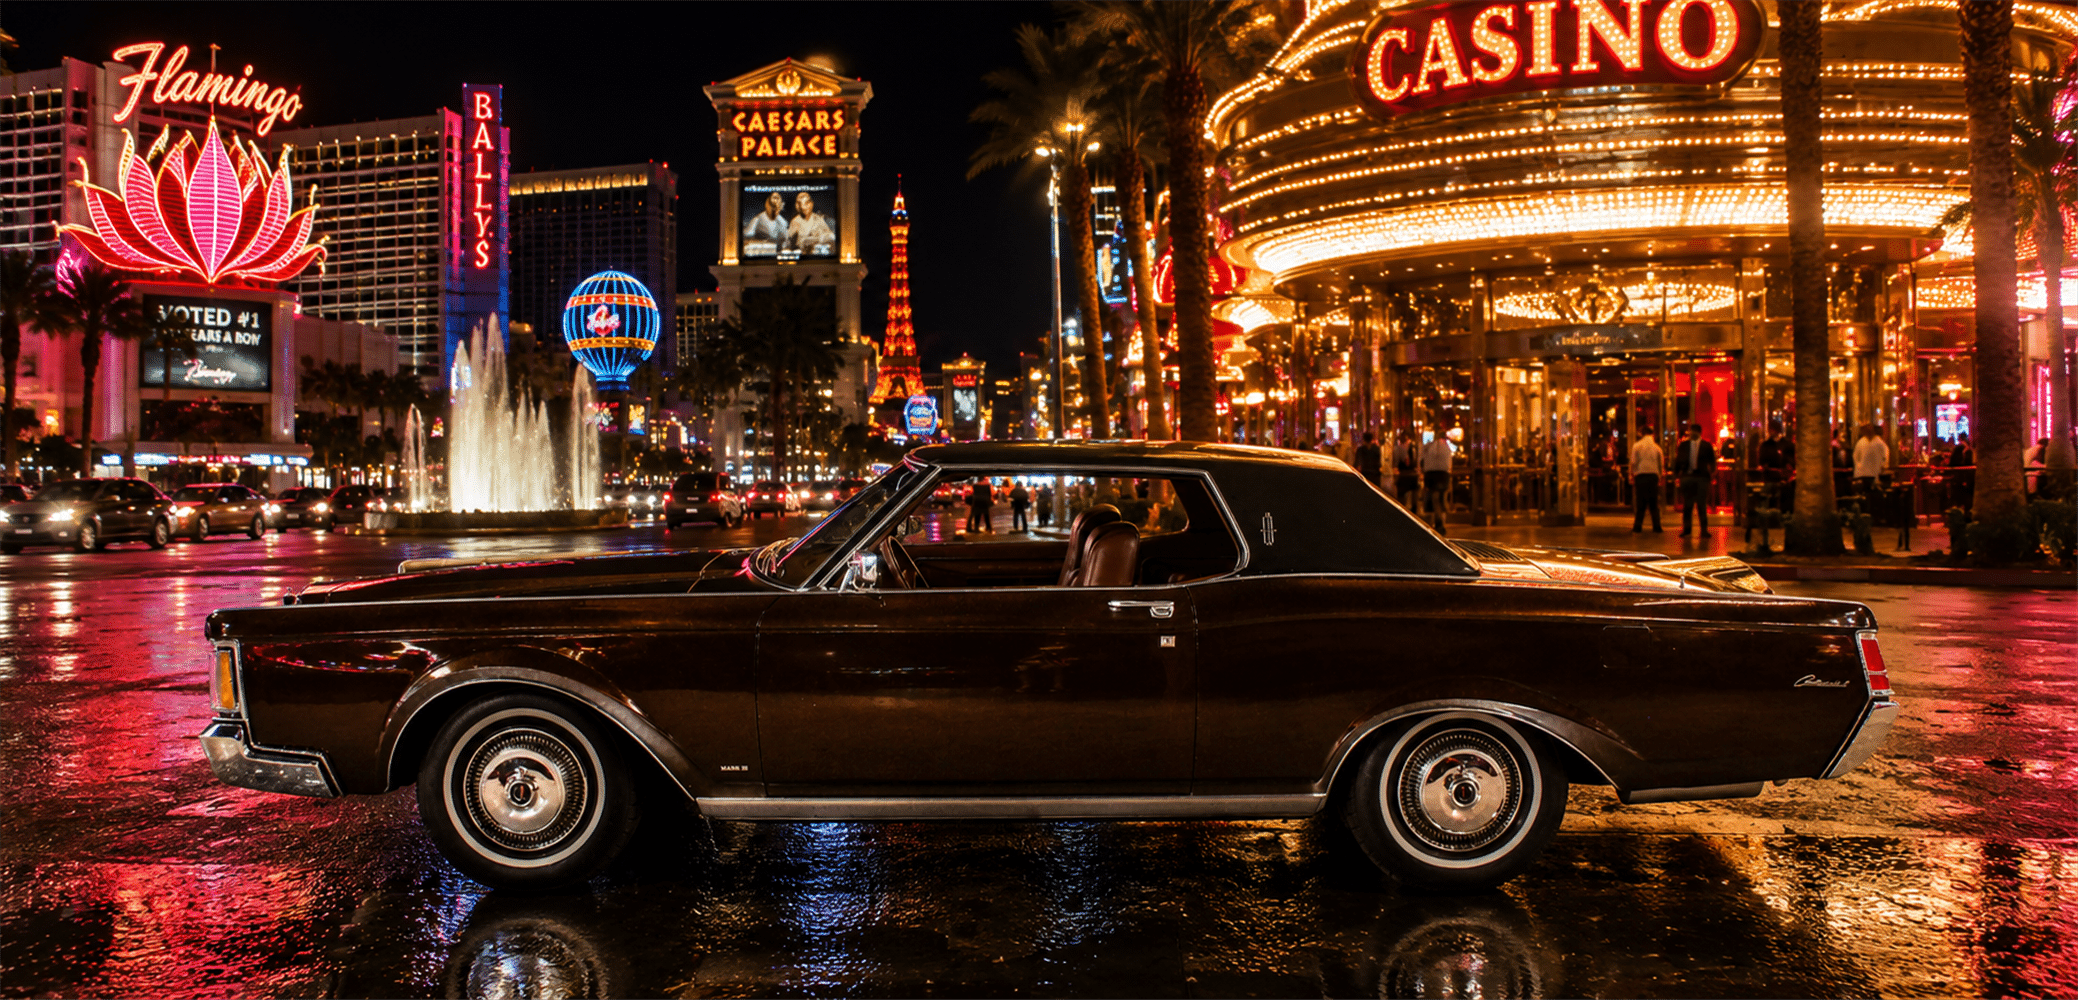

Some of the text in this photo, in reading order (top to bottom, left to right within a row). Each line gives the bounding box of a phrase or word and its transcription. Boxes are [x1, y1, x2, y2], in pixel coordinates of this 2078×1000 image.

[1366, 0, 1740, 102] CASINO
[113, 42, 303, 136] Flamingo
[733, 109, 845, 132] CAESARS
[741, 134, 837, 157] PALACE
[472, 92, 494, 269] BALLY'S
[237, 311, 260, 328] #1
